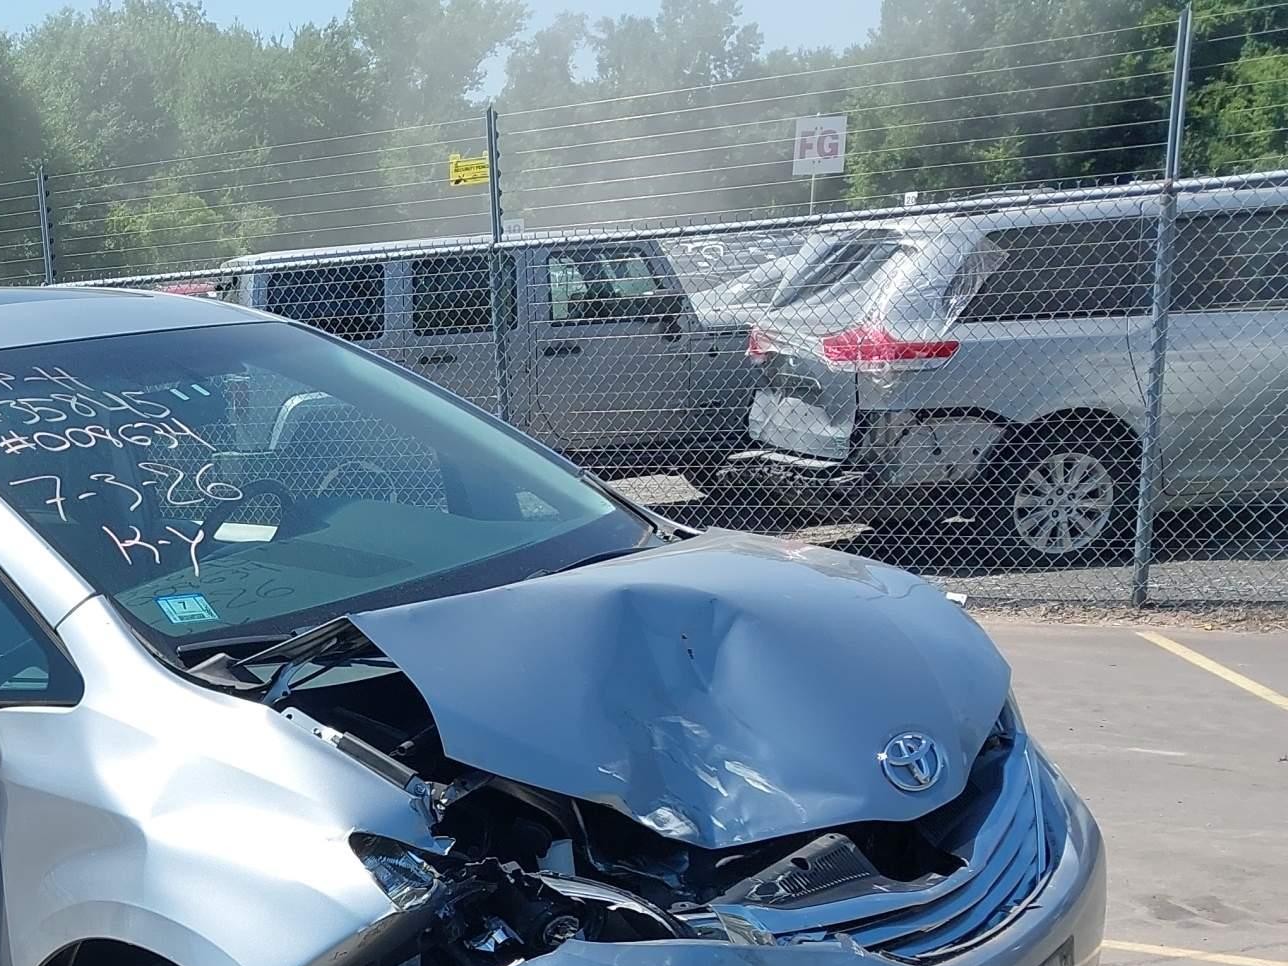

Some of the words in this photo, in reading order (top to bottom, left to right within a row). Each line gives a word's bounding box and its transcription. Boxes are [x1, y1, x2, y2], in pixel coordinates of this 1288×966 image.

[799, 129, 839, 160] FG
[9, 462, 244, 522] 7-3-26
[178, 601, 187, 610] 7
